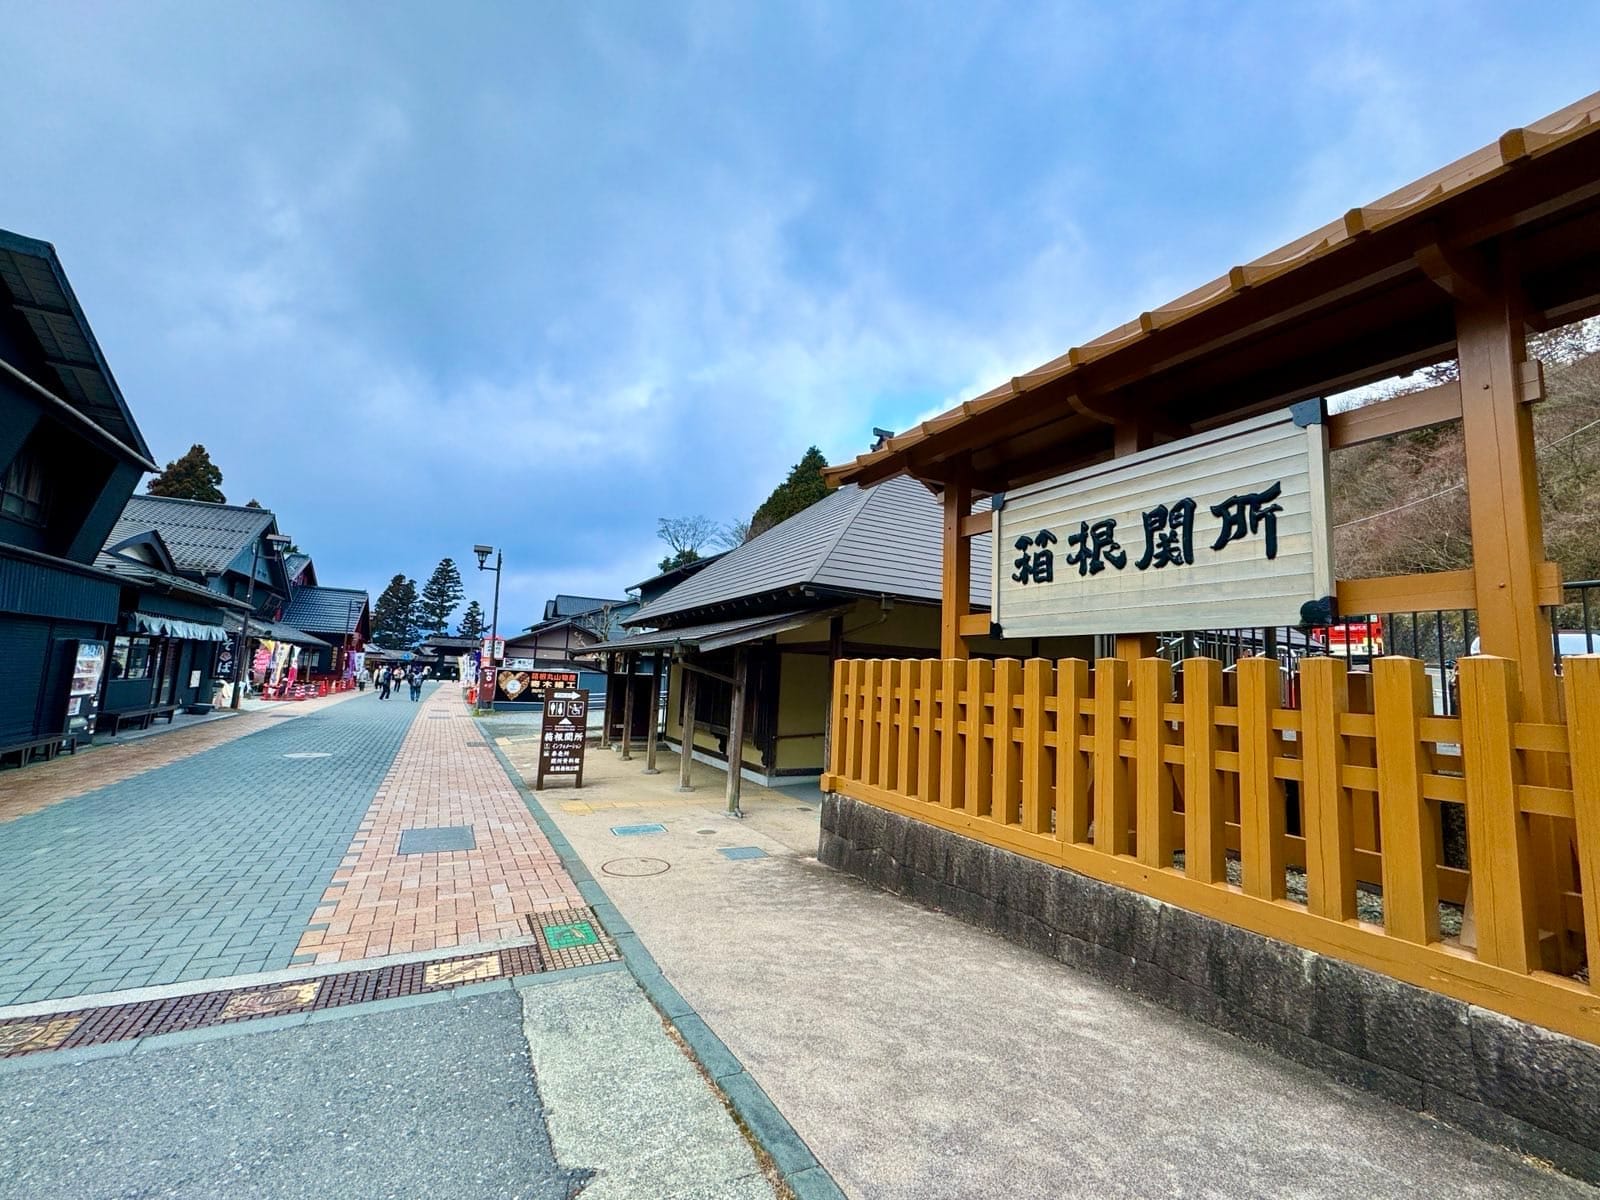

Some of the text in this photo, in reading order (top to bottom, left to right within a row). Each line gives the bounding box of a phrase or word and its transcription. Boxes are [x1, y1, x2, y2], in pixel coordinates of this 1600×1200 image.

[1011, 480, 1284, 586] 箱根関所
[216, 638, 235, 673] そば
